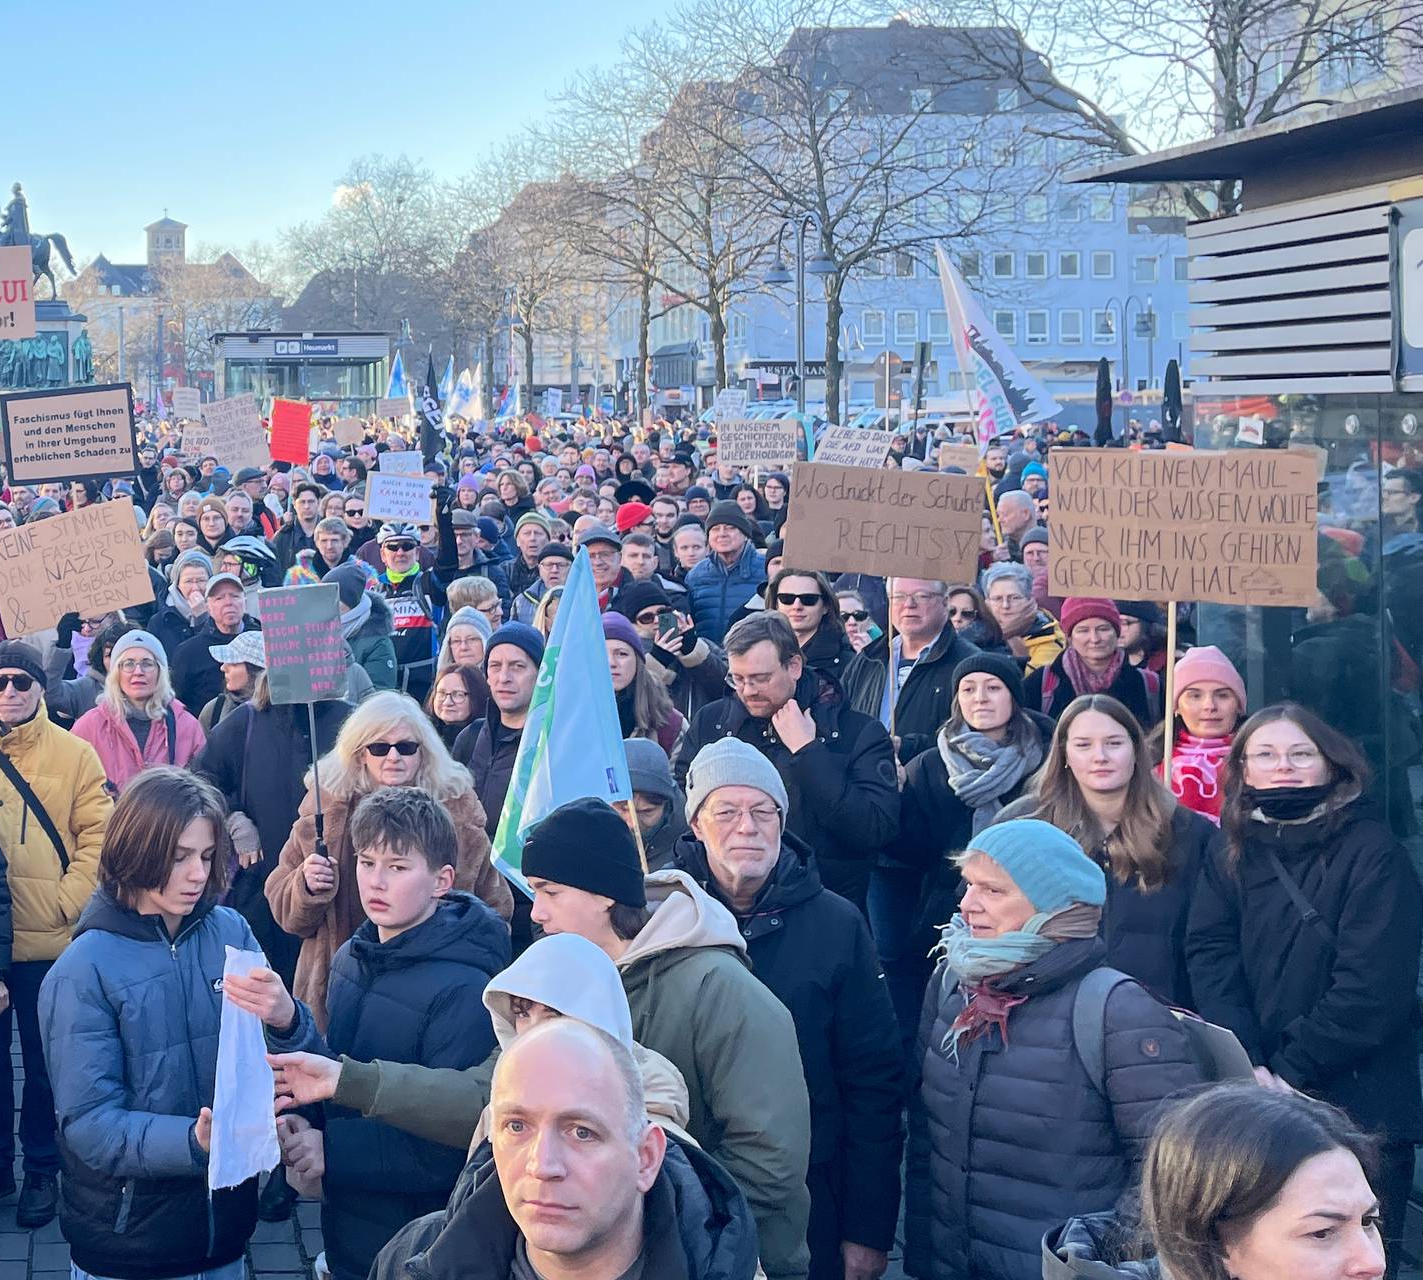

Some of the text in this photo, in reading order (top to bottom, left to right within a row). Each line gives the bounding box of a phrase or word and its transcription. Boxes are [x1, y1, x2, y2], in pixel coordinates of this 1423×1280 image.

[303, 344, 335, 352] Heumarkt
[13, 411, 71, 425] Faschismus
[73, 409, 94, 421] fügt
[96, 407, 124, 418] Ihnen
[24, 421, 116, 437] und den Menschen
[720, 422, 780, 433] IN UNSEREM
[830, 429, 855, 440] LEBE
[859, 431, 871, 441] SO
[25, 434, 117, 450] in Ihrer Umgebung
[720, 441, 732, 451] IST
[13, 447, 131, 464] erheblichen Schaden zu
[1052, 456, 1102, 484] VOM
[1112, 458, 1211, 489] KLEINEN
[794, 467, 827, 500] Wo
[888, 478, 919, 507] der
[1119, 490, 1162, 520] DER
[1170, 489, 1253, 524] WISSEN
[51, 505, 116, 542] STIMME
[1050, 522, 1302, 565] WER IHM INS GEHIRN
[44, 549, 114, 584] NAZIS
[1054, 555, 1180, 593] GESCHISSEN
